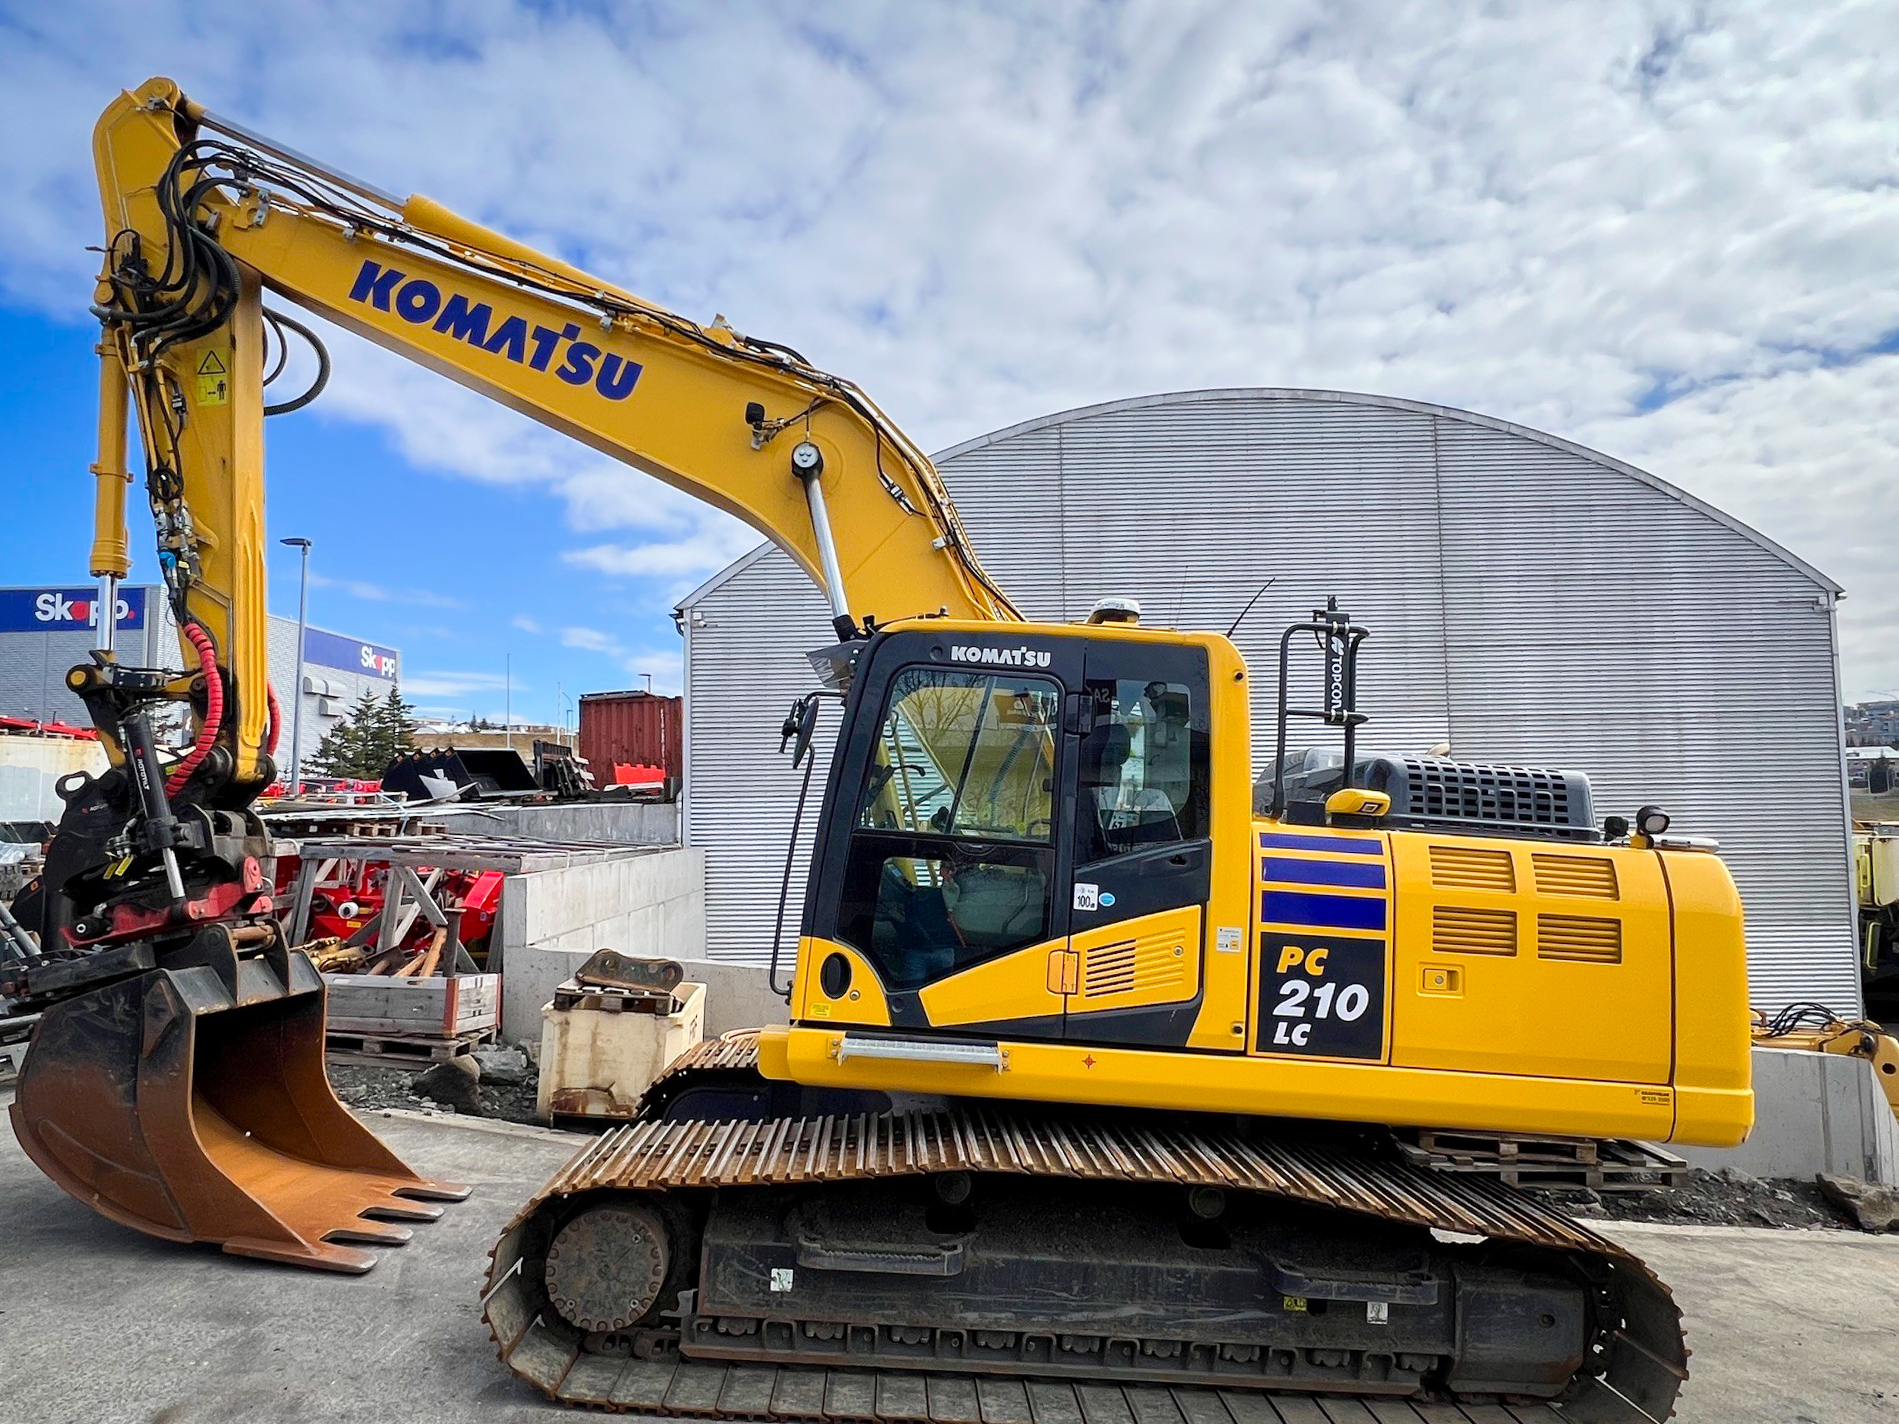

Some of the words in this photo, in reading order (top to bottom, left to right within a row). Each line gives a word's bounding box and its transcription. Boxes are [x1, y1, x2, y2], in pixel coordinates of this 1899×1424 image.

[349, 259, 643, 401] KOMATSU
[951, 646, 1051, 667] KOMATSU
[1331, 656, 1343, 709] TOPCON
[1077, 895, 1091, 908] 100
[1276, 945, 1329, 976] PC
[1272, 979, 1370, 1022] 210
[1273, 1022, 1312, 1046] LC
